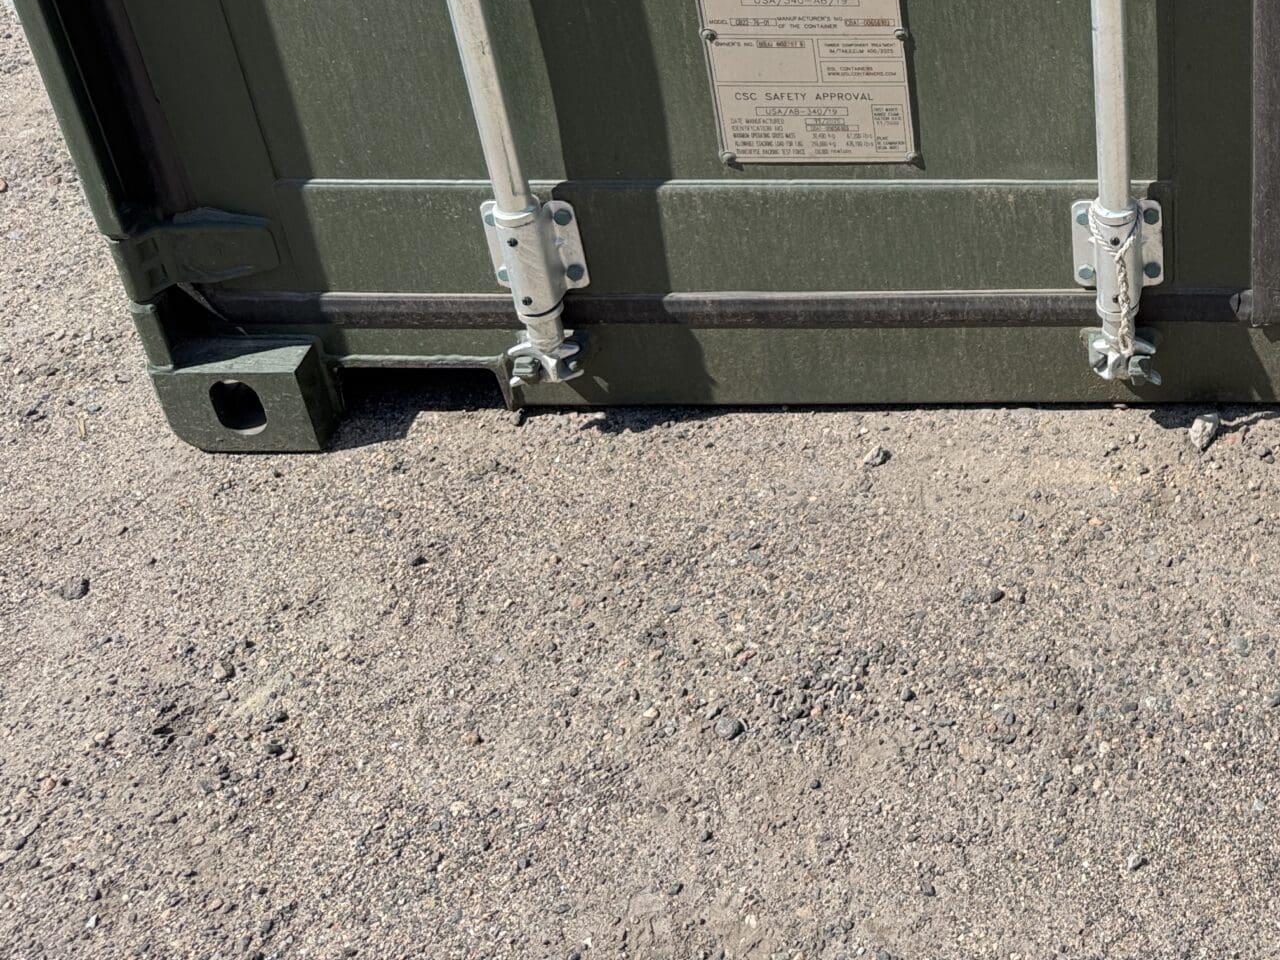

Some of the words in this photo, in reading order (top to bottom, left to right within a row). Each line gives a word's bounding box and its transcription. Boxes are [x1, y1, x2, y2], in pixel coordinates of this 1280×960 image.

[734, 92, 758, 101] CSC
[765, 92, 807, 101] SAFETY
[815, 92, 874, 102] APPROVAL
